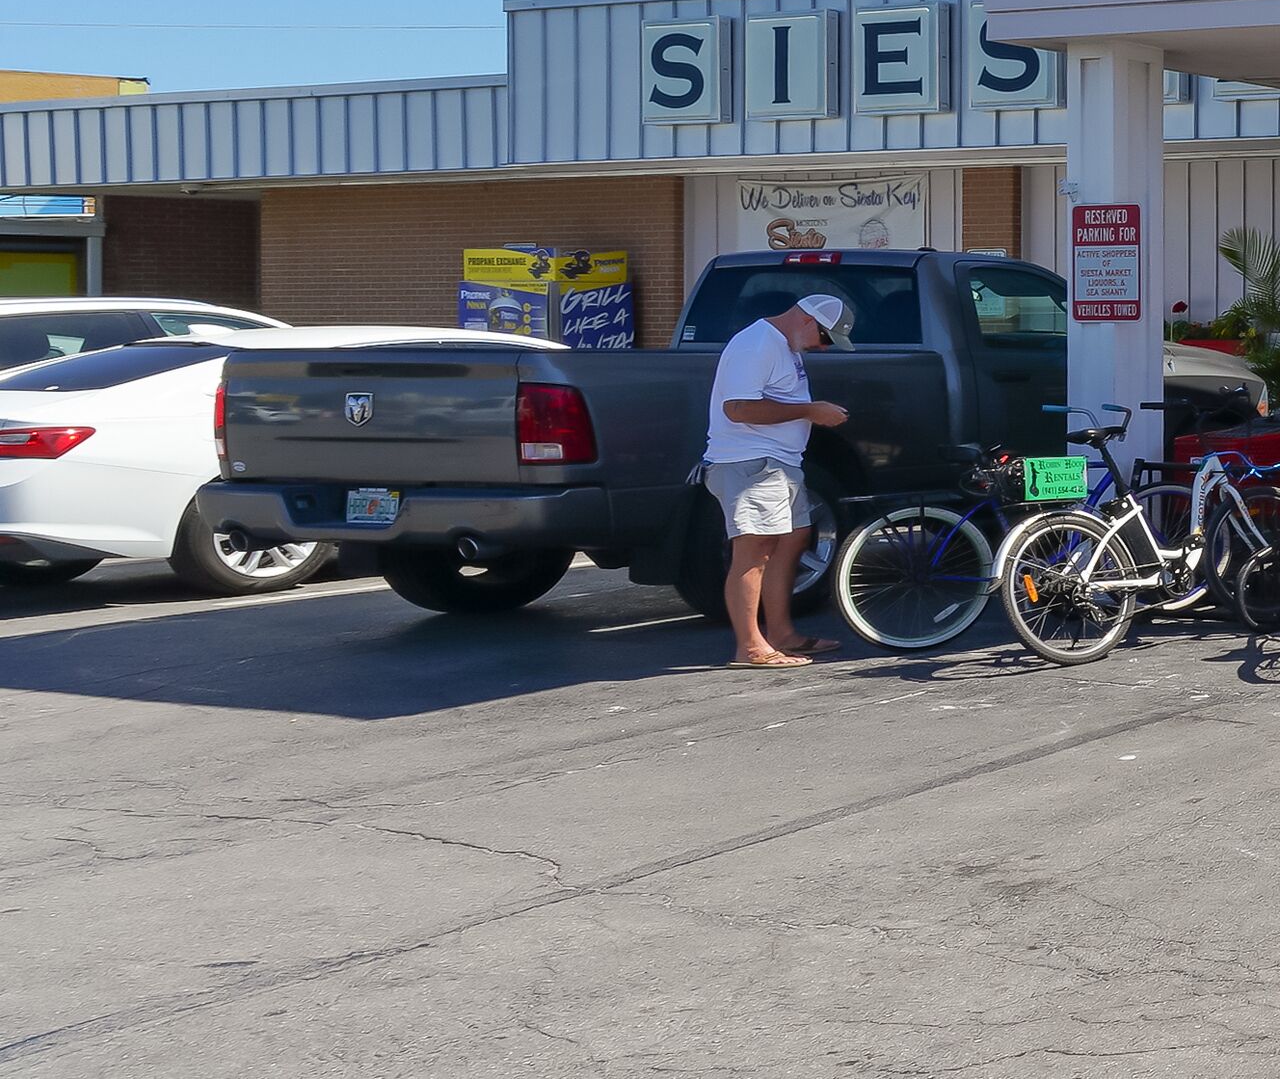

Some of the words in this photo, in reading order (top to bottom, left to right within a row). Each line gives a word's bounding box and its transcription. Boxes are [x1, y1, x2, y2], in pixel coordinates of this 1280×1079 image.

[649, 17, 1040, 109] SIES
[740, 185, 768, 211] We
[771, 185, 820, 210] Deliver
[822, 194, 835, 207] on
[838, 182, 883, 209] Siesta
[886, 181, 921, 211] Key!
[1085, 209, 1128, 224] RESERVED
[1077, 227, 1115, 242] PARKING
[1119, 227, 1136, 241] FOR
[1077, 250, 1100, 258] ACTIVE
[1101, 249, 1136, 258] SHOPPERS
[467, 257, 495, 266] PROPANE
[496, 257, 527, 266] EXCHANGE
[1080, 269, 1103, 277] SIESTA
[1120, 279, 1125, 287] &
[561, 284, 632, 314] GRILL
[1086, 288, 1100, 296] SEA
[1101, 288, 1128, 296] SHANTY
[1077, 304, 1111, 317] VEHICLES
[1113, 304, 1137, 316] TOWED
[563, 312, 611, 336] LIKE
[612, 308, 630, 326] A
